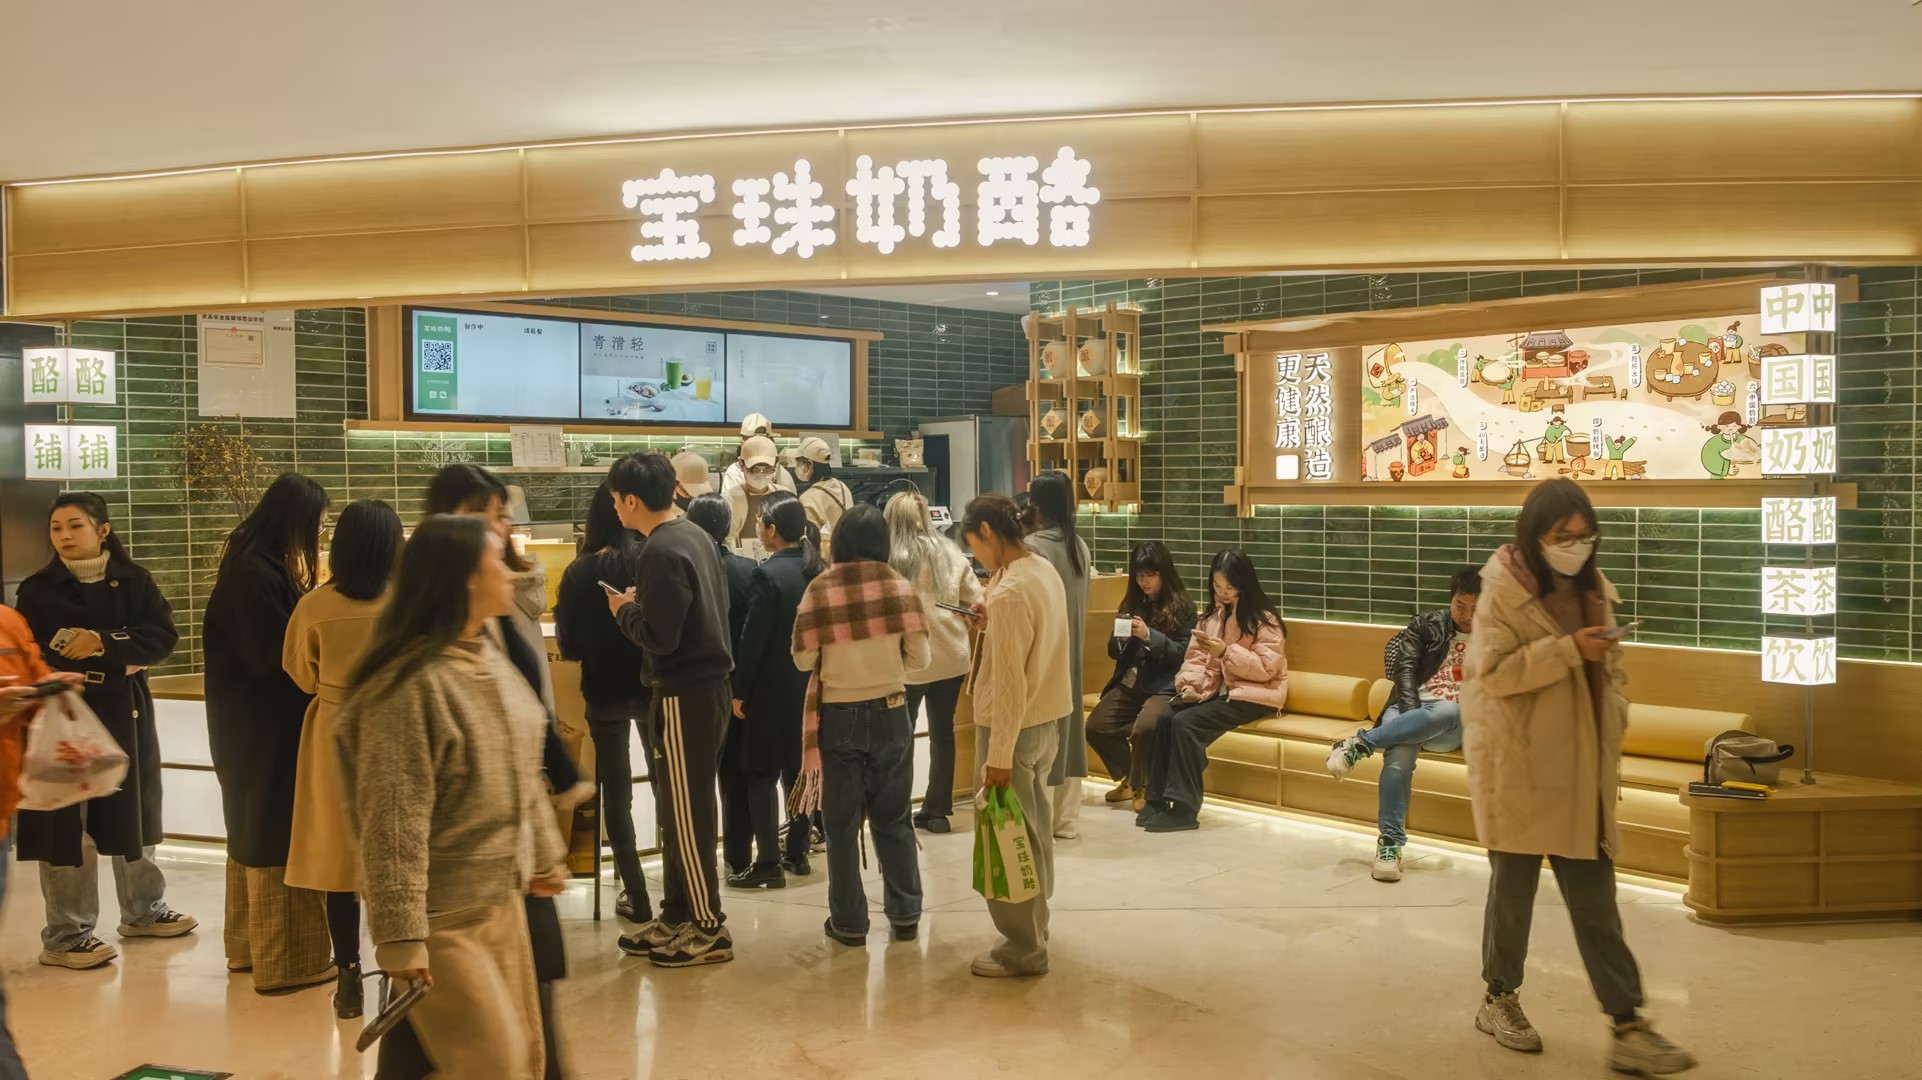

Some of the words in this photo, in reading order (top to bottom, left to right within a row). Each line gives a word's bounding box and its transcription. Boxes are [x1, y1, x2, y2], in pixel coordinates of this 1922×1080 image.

[622, 146, 1100, 261] 宝珠奶酪
[1275, 354, 1301, 448] 更健康
[1304, 353, 1332, 480] 天然酿造
